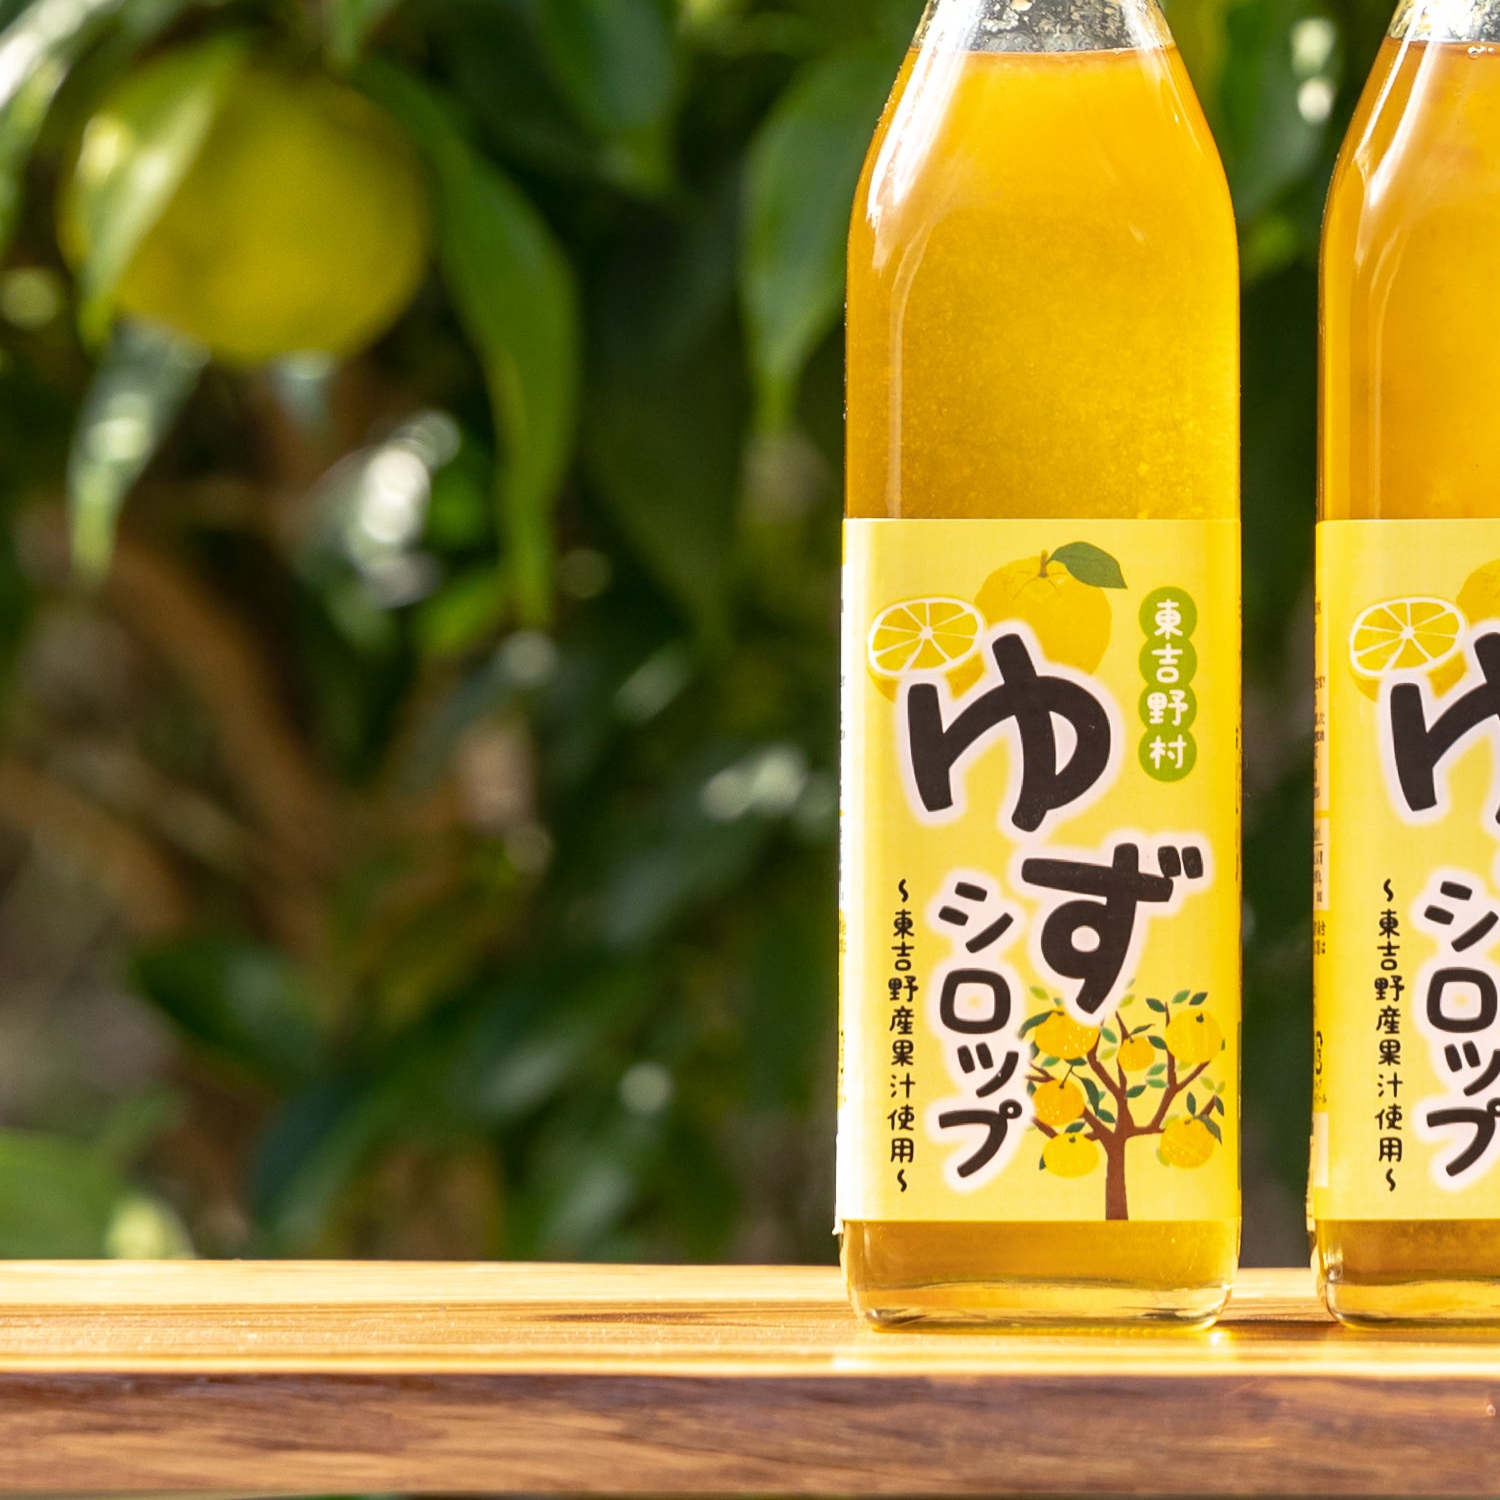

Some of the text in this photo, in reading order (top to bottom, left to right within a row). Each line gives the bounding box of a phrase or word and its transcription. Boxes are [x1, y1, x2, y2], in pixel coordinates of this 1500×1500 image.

[908, 633, 1204, 1014] ゆず
[1147, 599, 1188, 769] 東吉野村
[938, 881, 1023, 1178] シロップ
